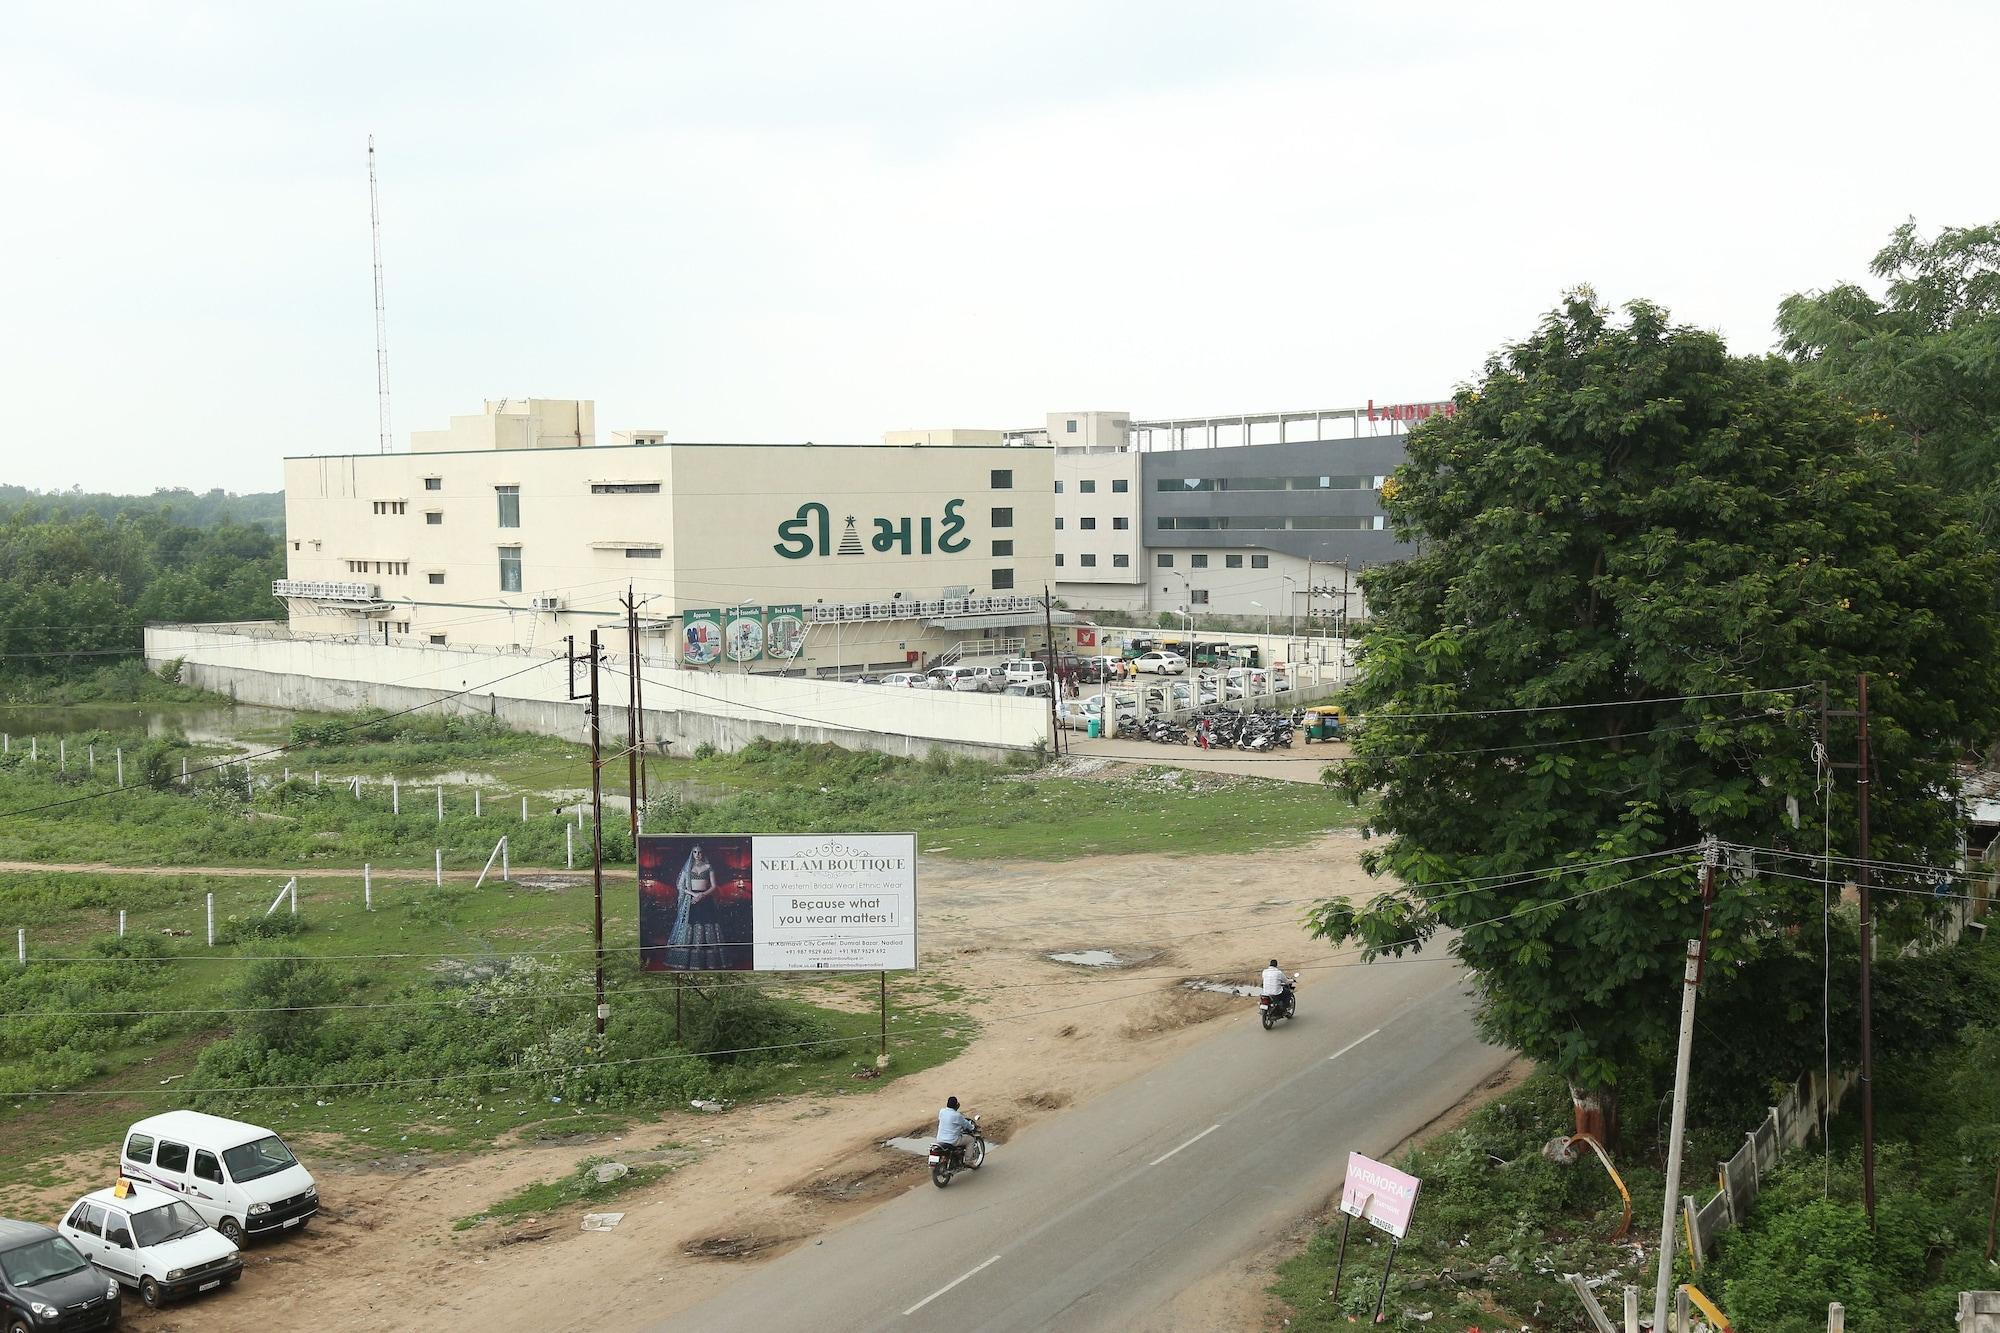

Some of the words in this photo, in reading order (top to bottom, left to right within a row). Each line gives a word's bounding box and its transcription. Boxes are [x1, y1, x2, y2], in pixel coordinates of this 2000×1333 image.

[773, 502, 830, 559] ડી
[871, 498, 971, 555] માર્ટ
[760, 860, 822, 871] NEELAM
[828, 859, 905, 872] BOUTIQUE
[859, 881, 881, 889] Ethnic
[791, 899, 845, 909] Because
[849, 898, 881, 908] what
[779, 915, 802, 926] you
[806, 915, 837, 924] wear
[841, 913, 887, 923] matters
[1349, 1164, 1403, 1197] VARMORA
